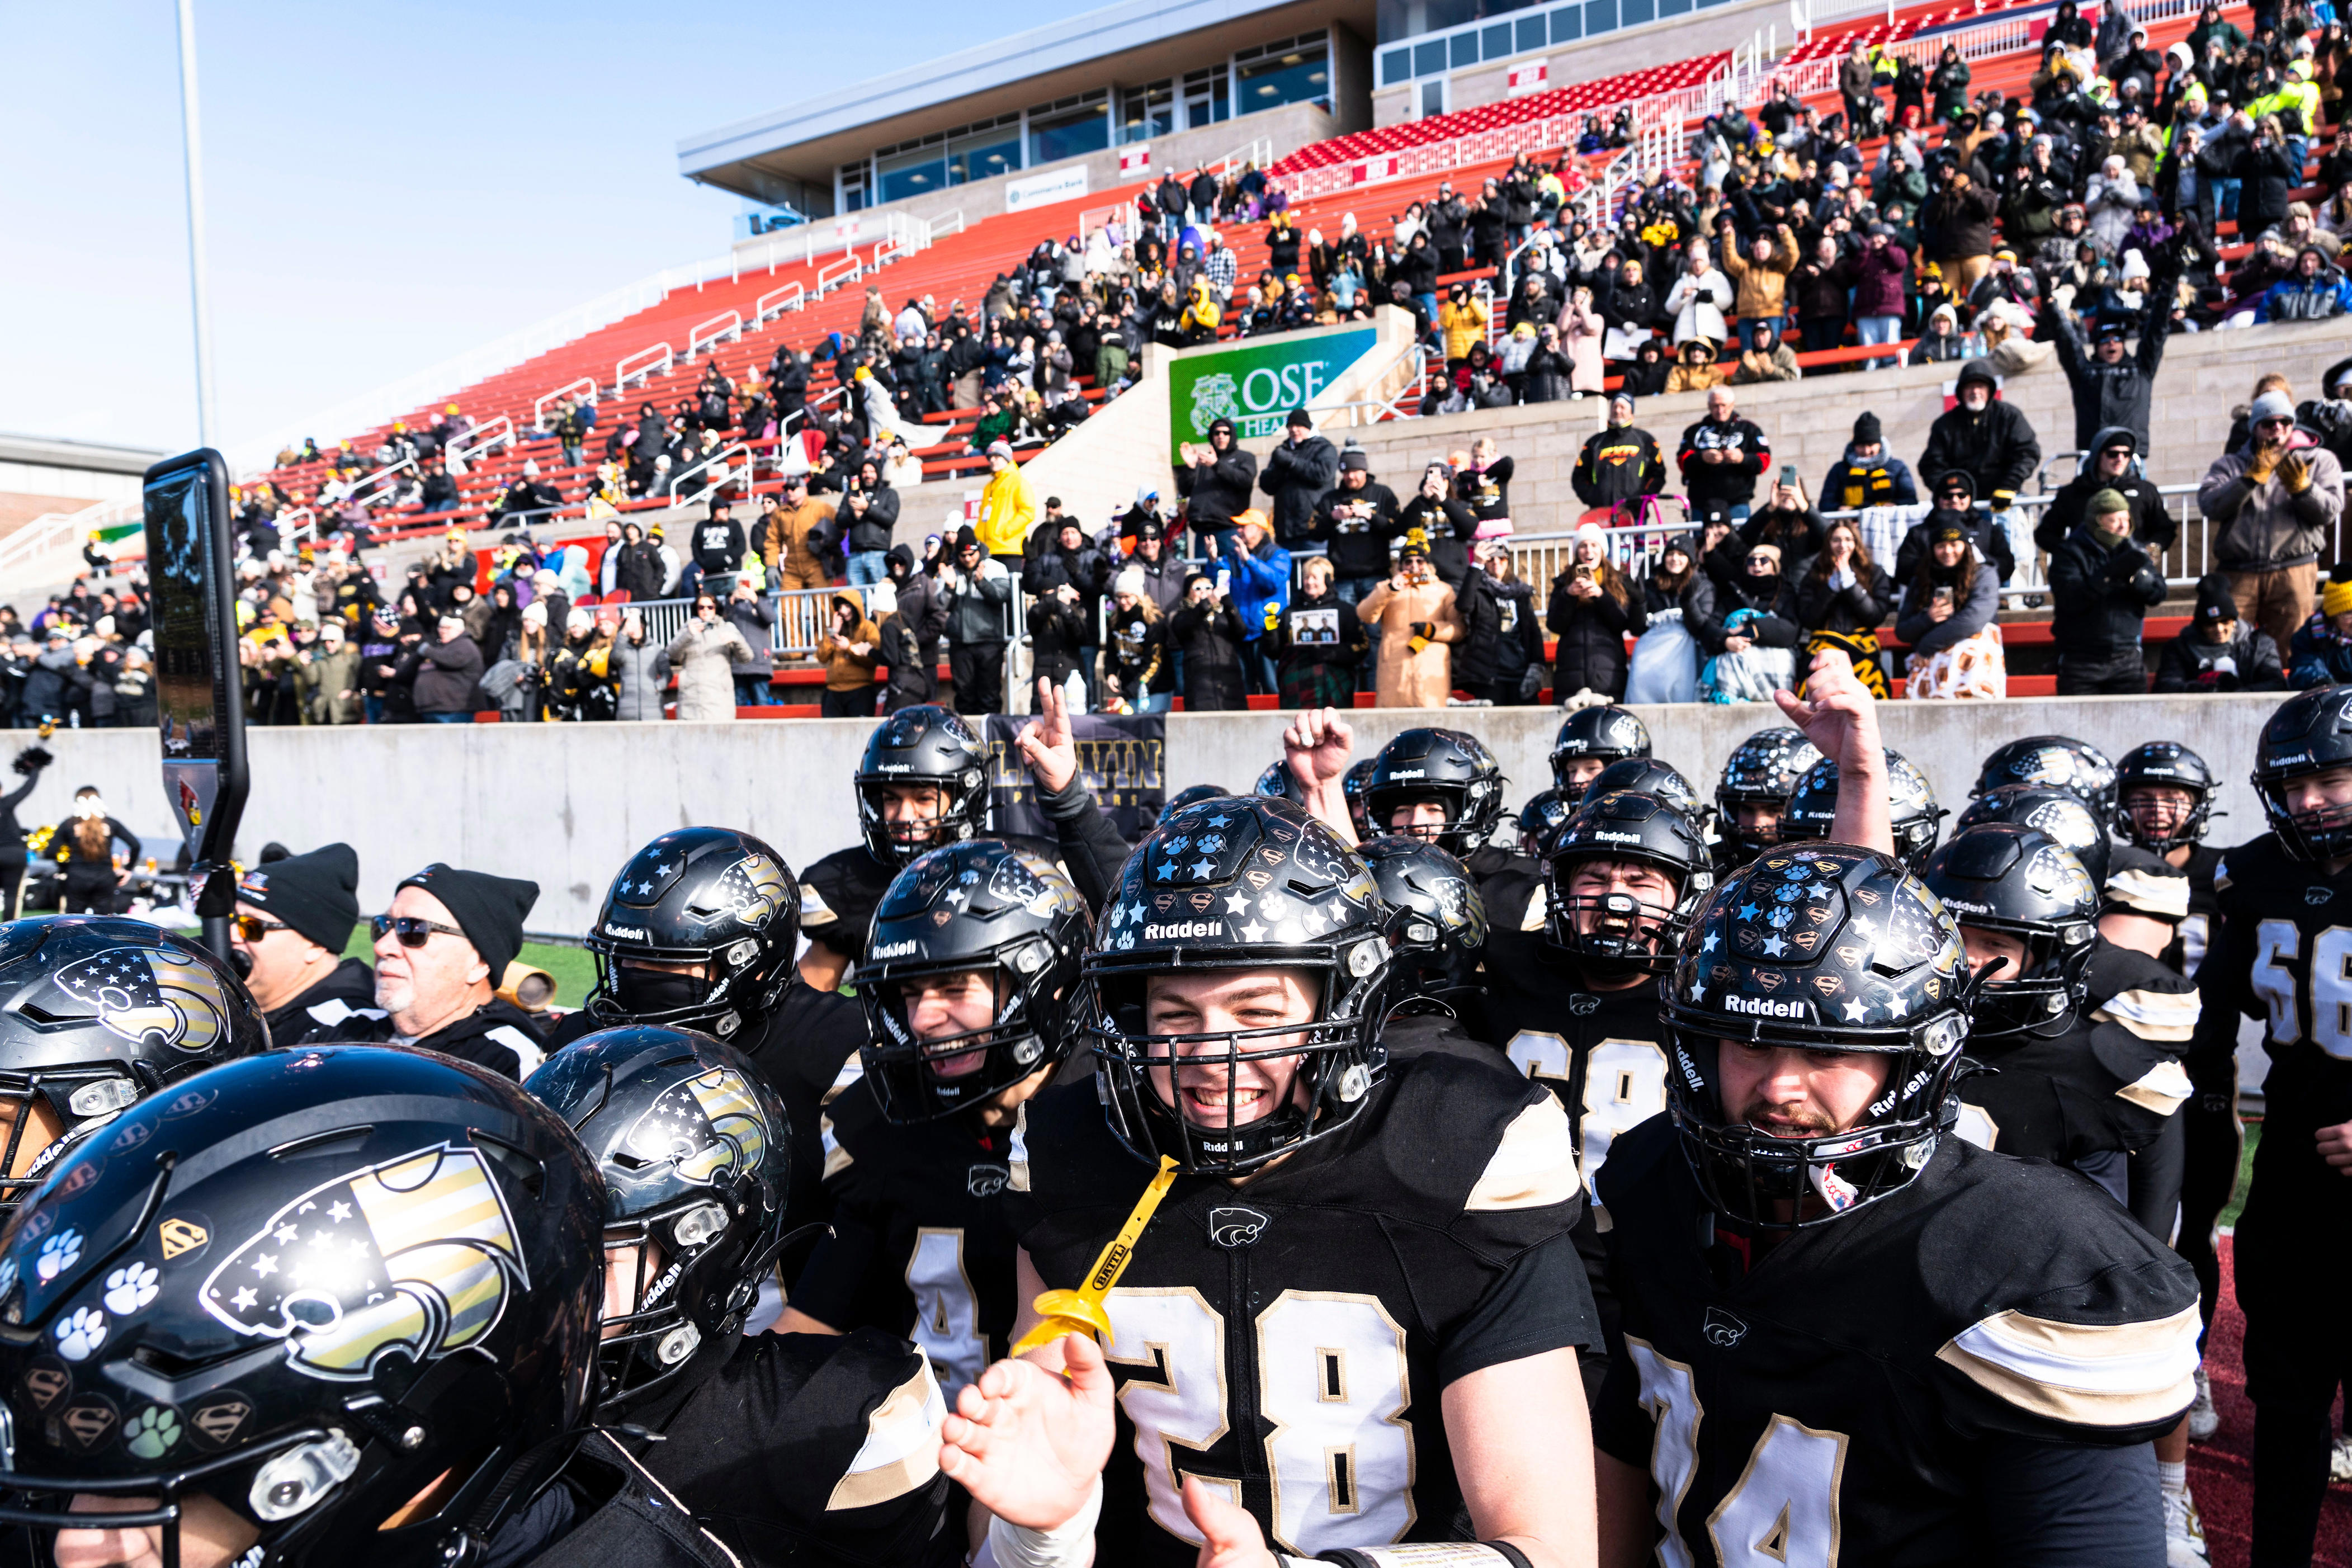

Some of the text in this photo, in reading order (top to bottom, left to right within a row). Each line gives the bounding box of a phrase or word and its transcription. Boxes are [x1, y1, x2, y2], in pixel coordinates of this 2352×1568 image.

[1243, 361, 1324, 412] OSF
[1595, 831, 1641, 844] Riddell
[1940, 896, 1987, 914] Riddell
[605, 923, 644, 940] Riddell
[1145, 922, 1221, 940] Riddell
[873, 939, 917, 960] Riddell
[1725, 995, 1804, 1018] Riddell
[1203, 1141, 1243, 1152] Riddll
[1097, 1244, 1126, 1285] BATTL
[641, 1263, 682, 1312] iddell
[904, 1226, 993, 1392] 4
[1099, 1286, 1418, 1559] 28
